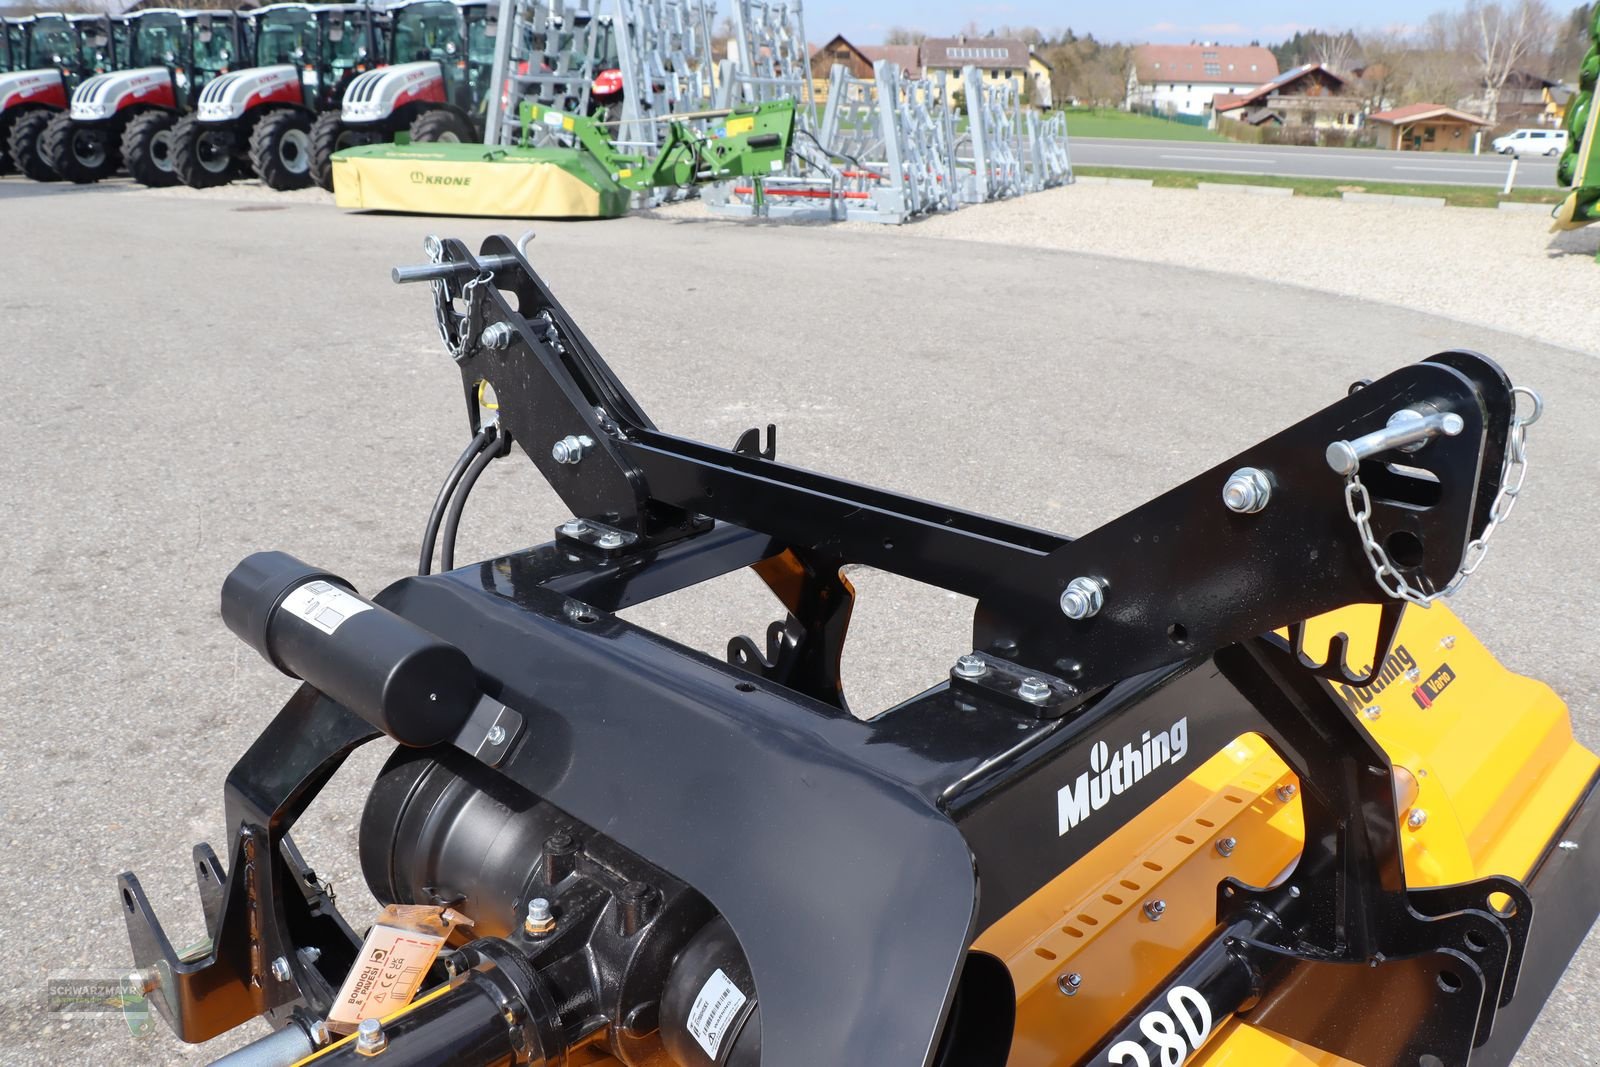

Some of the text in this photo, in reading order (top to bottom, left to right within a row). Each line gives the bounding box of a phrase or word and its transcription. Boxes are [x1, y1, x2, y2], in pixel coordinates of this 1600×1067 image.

[425, 175, 472, 186] KRONE
[1426, 671, 1450, 693] Vario
[348, 966, 372, 1004] BONDIOLI
[361, 967, 379, 995] PAVESI
